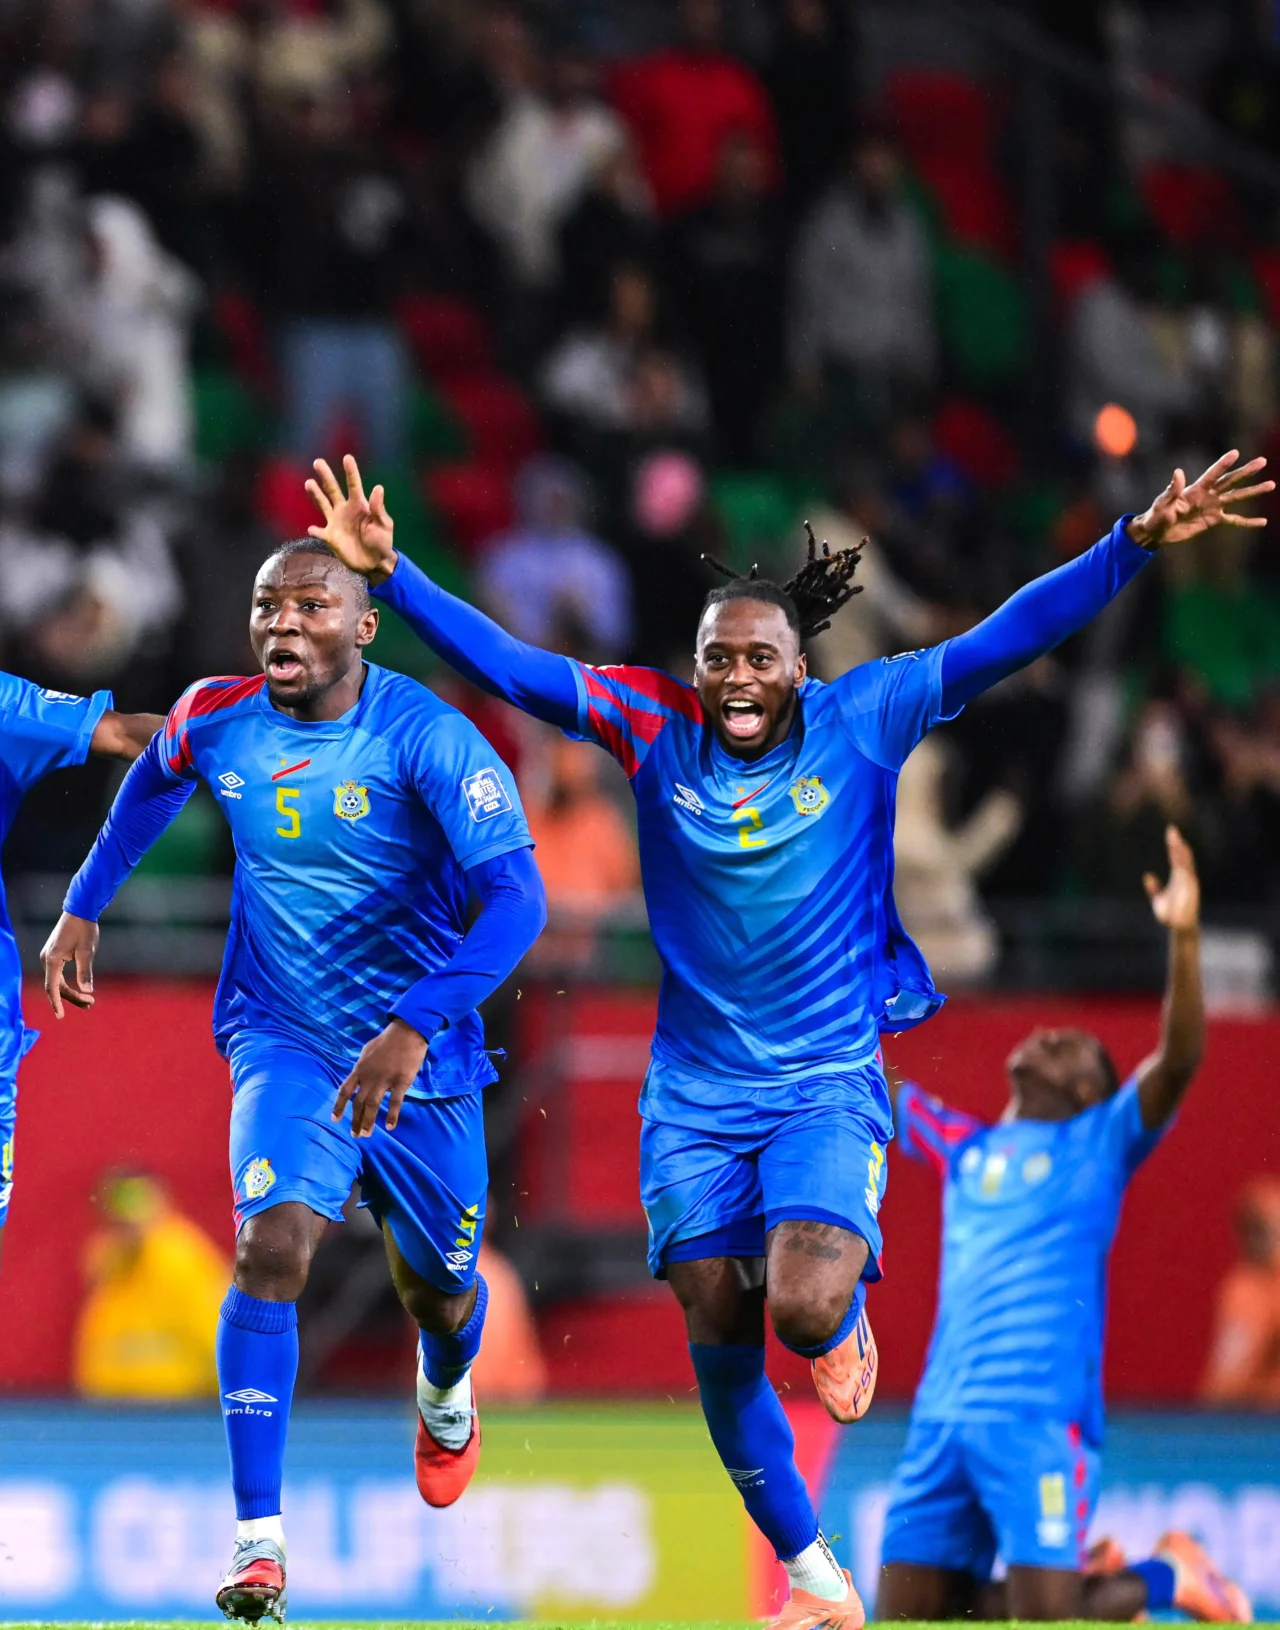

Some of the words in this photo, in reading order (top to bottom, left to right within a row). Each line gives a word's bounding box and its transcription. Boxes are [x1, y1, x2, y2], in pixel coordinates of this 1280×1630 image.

[220, 788, 242, 800] umbro
[673, 794, 702, 816] umbro
[802, 799, 825, 812] FECOFA
[276, 787, 301, 839] 5
[340, 809, 364, 818] FECOFA
[732, 807, 767, 848] 2
[225, 1404, 273, 1417] umbro
